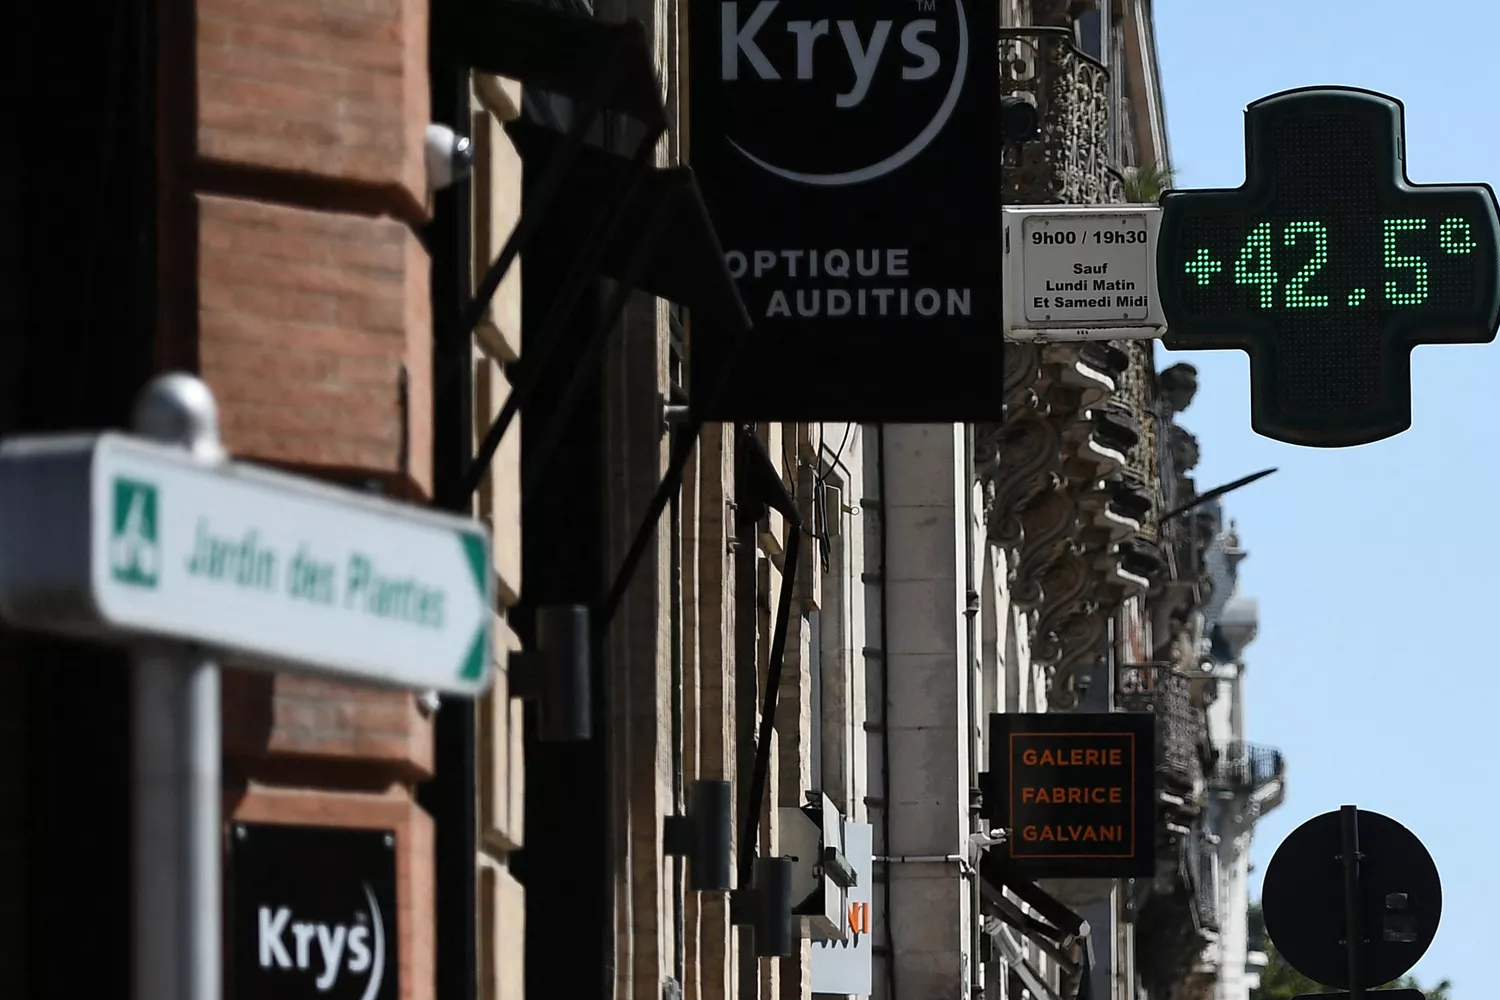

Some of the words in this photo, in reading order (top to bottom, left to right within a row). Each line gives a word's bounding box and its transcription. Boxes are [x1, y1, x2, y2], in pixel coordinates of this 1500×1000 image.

[721, 0, 941, 108] Krys
[1032, 231, 1076, 245] 9h00
[1092, 230, 1147, 244] 19h30
[725, 249, 909, 279] OPTIQUE
[1073, 262, 1108, 275] Sauf
[1046, 279, 1088, 292] Lundi
[1092, 279, 1135, 291] Matin
[765, 288, 971, 317] AUDITION
[1033, 296, 1050, 309] Et
[1054, 296, 1111, 308] Samedi
[1116, 295, 1148, 308] Midi
[184, 516, 278, 591] Jardin
[287, 542, 335, 605] des
[343, 551, 447, 631] Plantes
[1022, 749, 1122, 766] GALERIE
[1021, 787, 1122, 804] FABRICE
[1022, 825, 1123, 842] GALVANI
[257, 905, 373, 991] Krys
